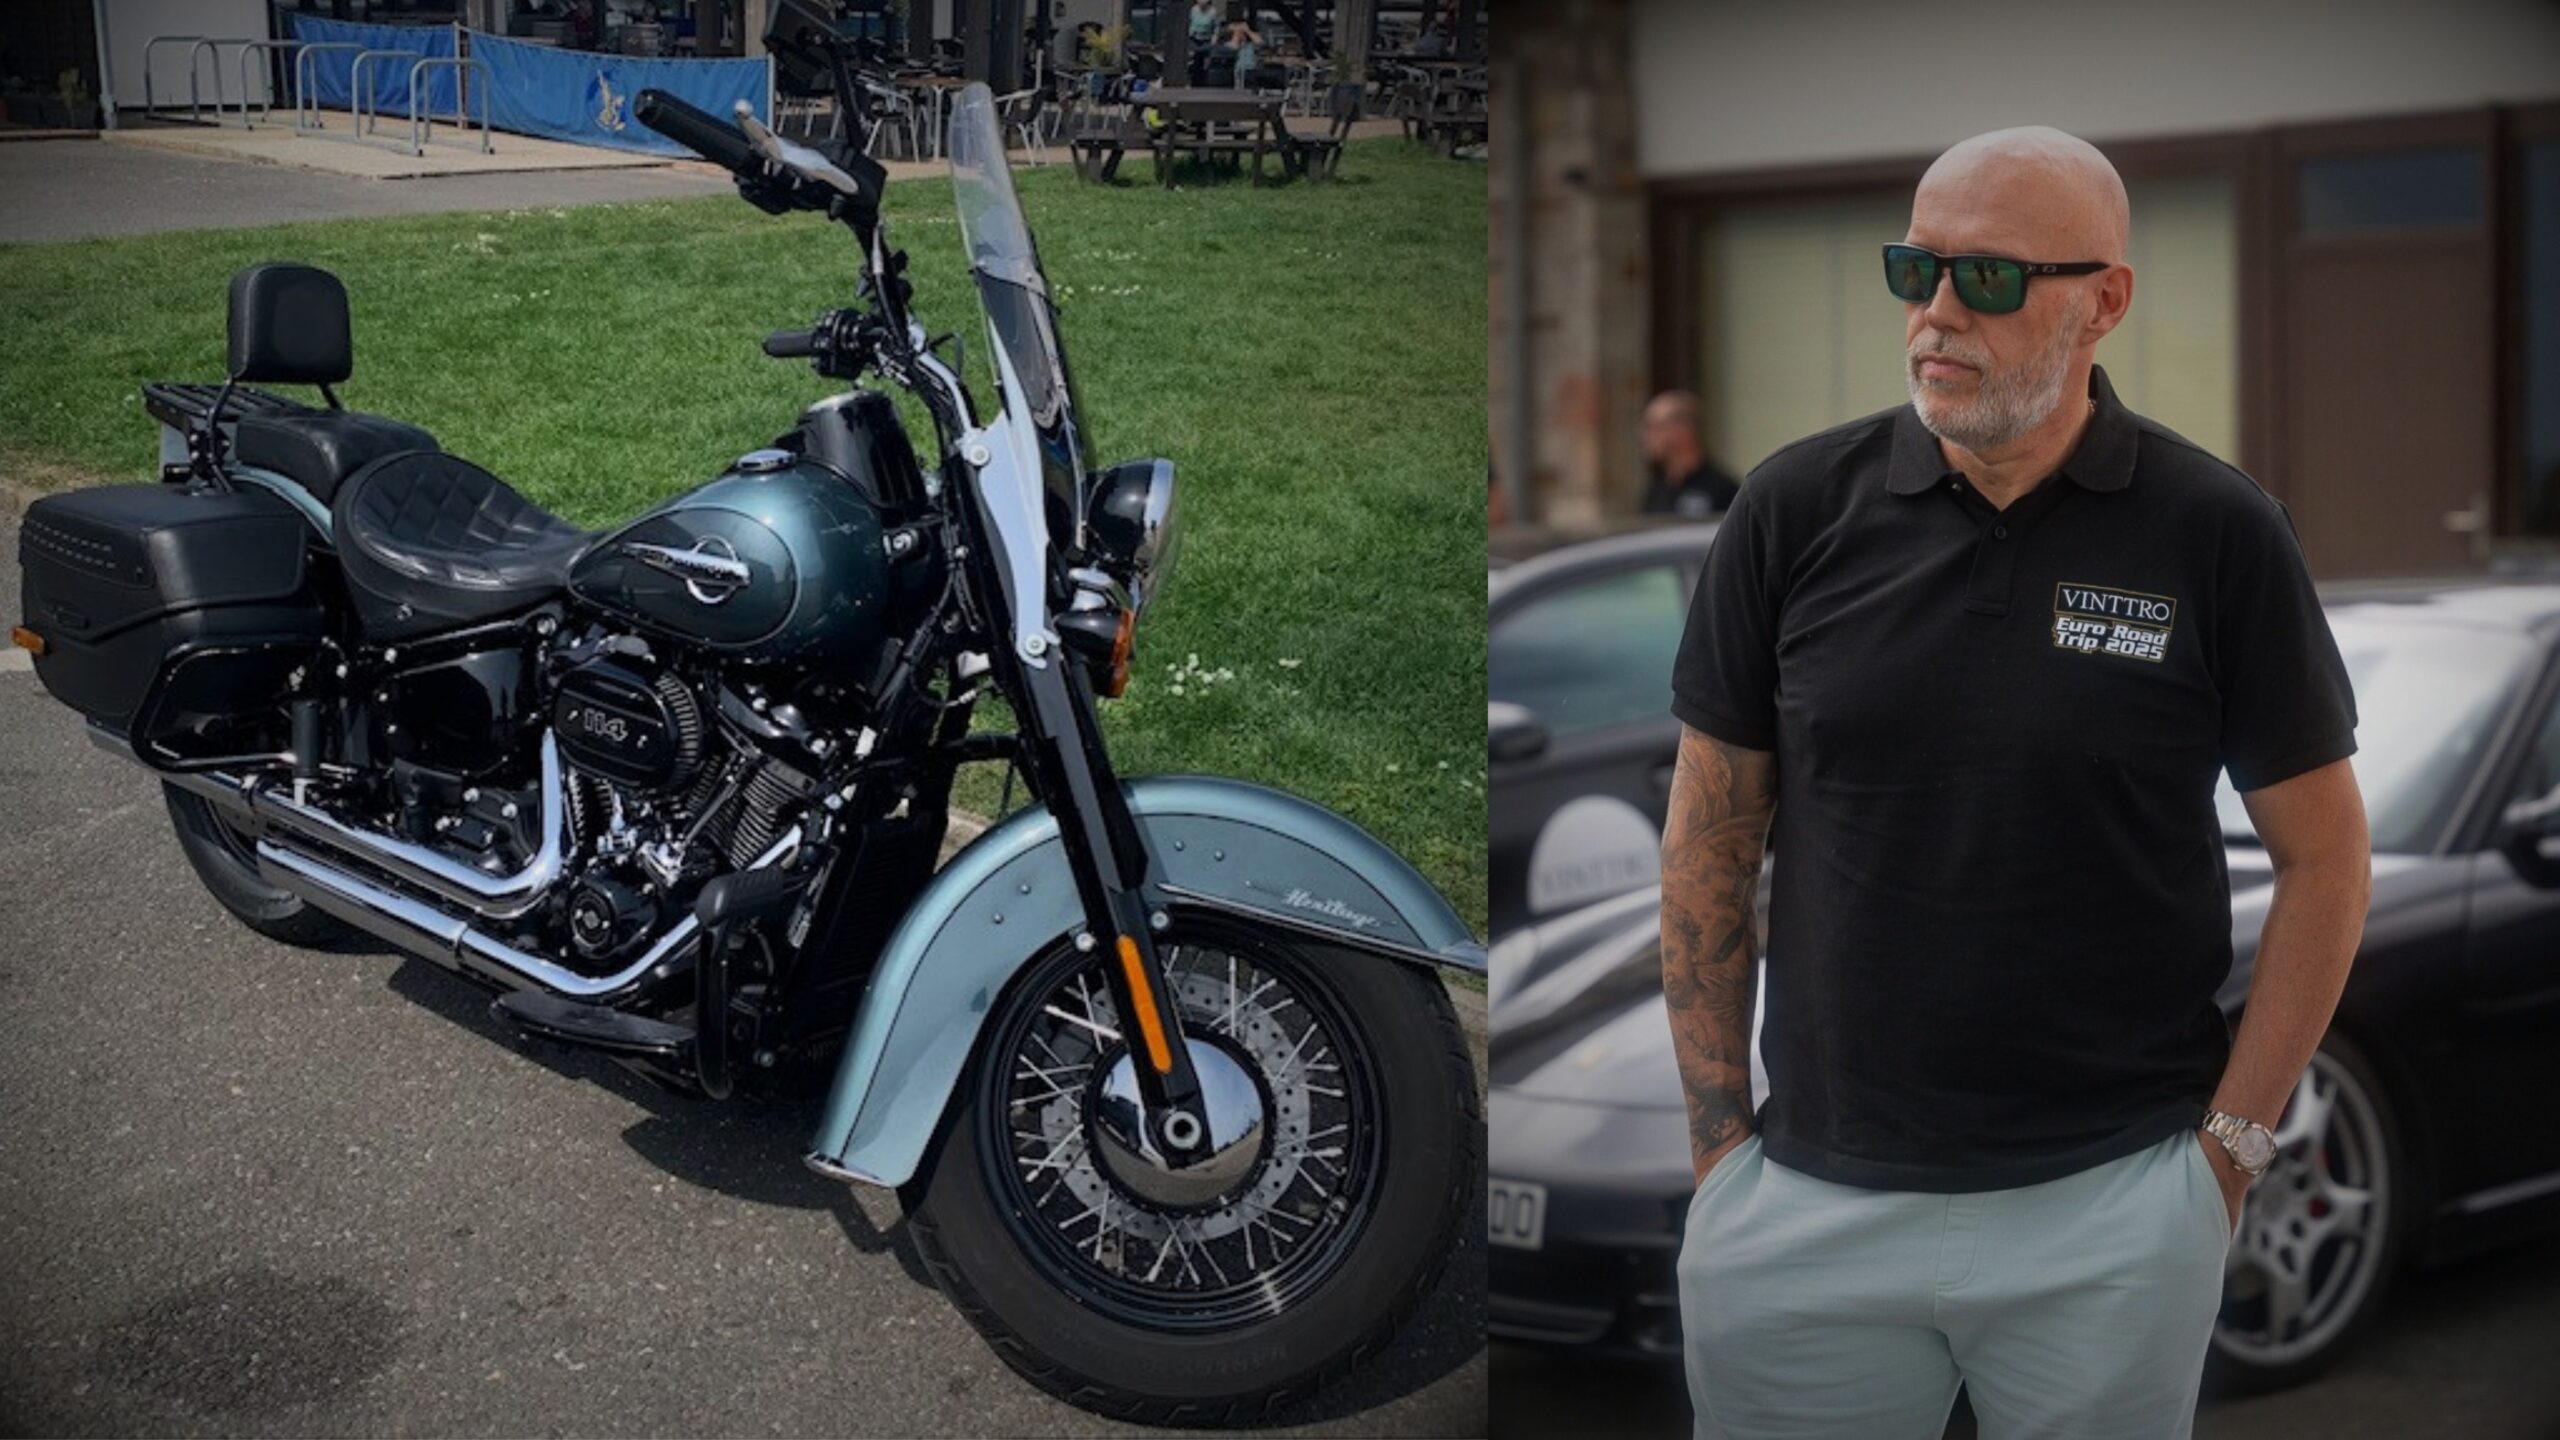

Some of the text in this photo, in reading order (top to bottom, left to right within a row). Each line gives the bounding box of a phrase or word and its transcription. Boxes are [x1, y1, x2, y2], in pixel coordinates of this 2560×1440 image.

[2062, 588, 2170, 621] VINTTRO
[2056, 616, 2168, 646] Euro Road
[2057, 631, 2164, 660] Trip 2025
[584, 707, 628, 741] 114
